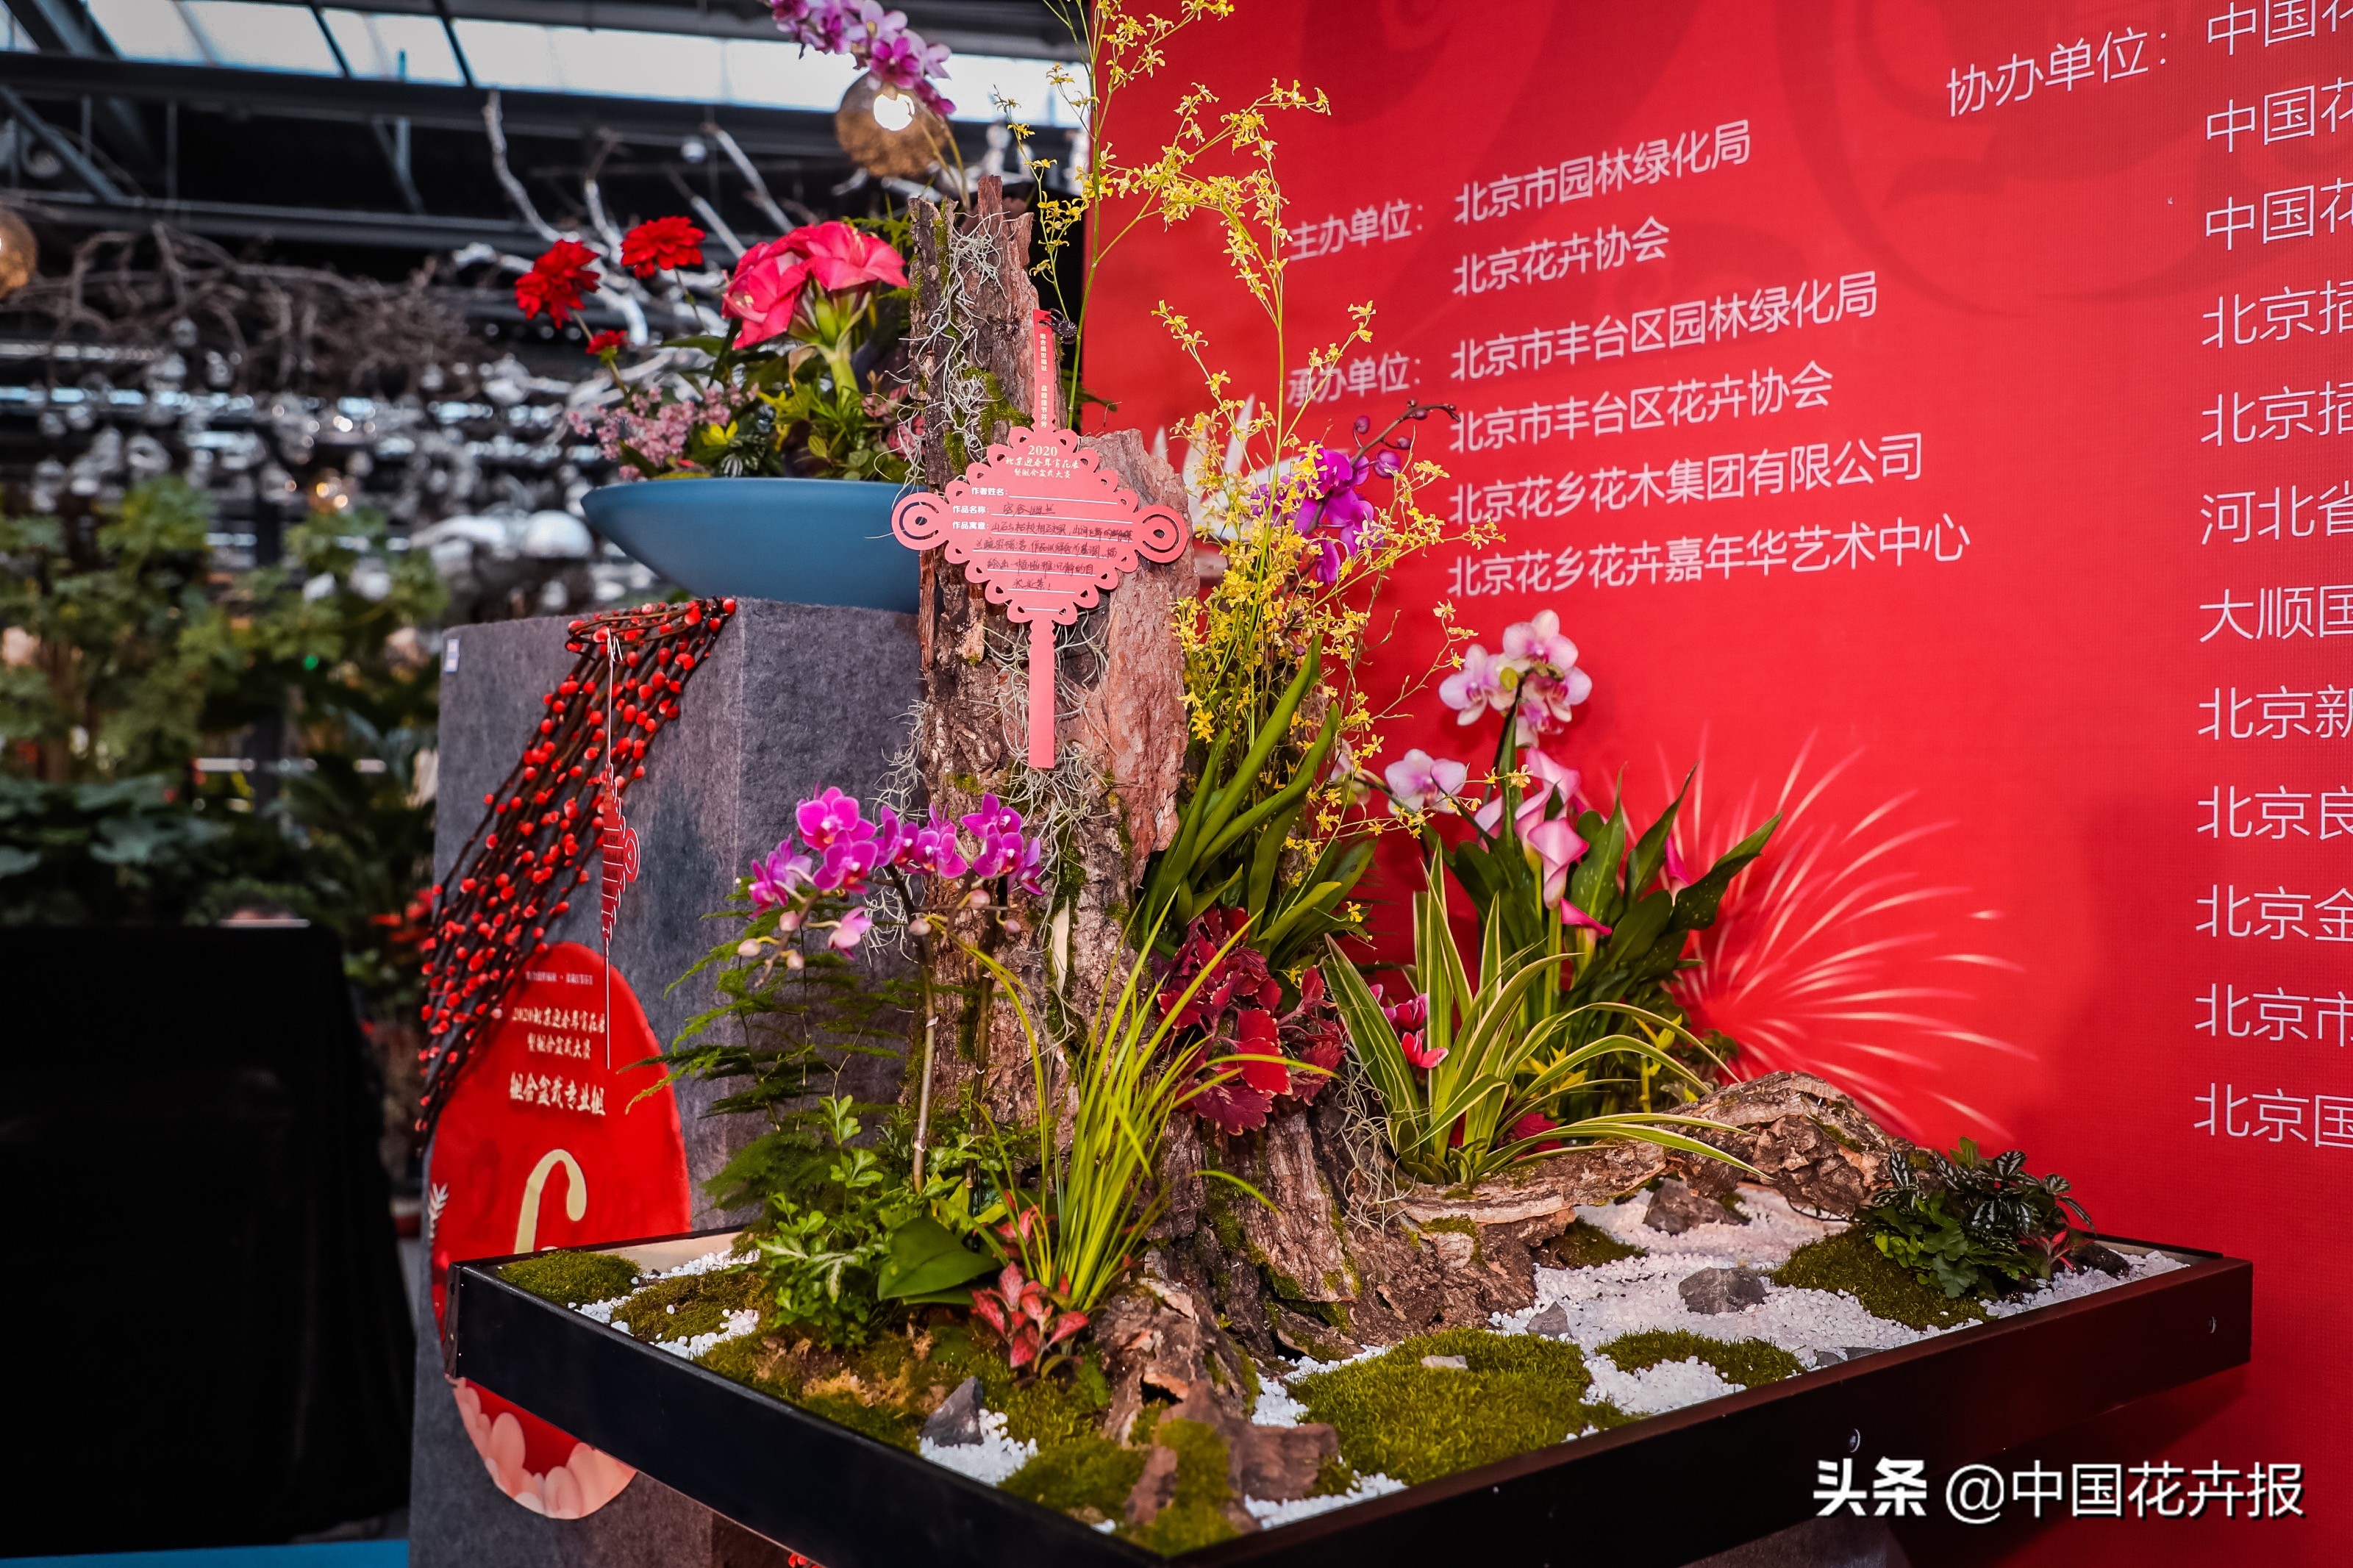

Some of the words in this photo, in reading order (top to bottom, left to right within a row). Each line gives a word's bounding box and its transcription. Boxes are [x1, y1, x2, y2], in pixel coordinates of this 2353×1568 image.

[1946, 26, 2166, 117] 协办单位：
[1289, 198, 1423, 261] 主办单位：
[1454, 120, 1750, 226] 北京市园林绿化局
[1453, 216, 1670, 296] 北京花卉协会
[1287, 351, 1421, 407] 承办单位：
[1451, 271, 1877, 382] 北京市丰台区园林绿化局
[1449, 361, 1834, 454] 北京市丰台区花卉协会
[1028, 445, 1058, 457] 2020
[1448, 433, 1923, 526] 北京花乡花木集团有限公司
[952, 505, 990, 514] 作品名称：
[971, 487, 1008, 496] 作者姓名：
[2200, 480, 2353, 545] 河北省
[951, 521, 989, 530] 作品寓意：
[1447, 512, 1971, 598] 北京花乡花卉嘉年华艺术中心
[2198, 684, 2353, 740] 北京新
[2196, 884, 2353, 942] 北京金
[2195, 983, 2353, 1047] 北京市
[2193, 1083, 2353, 1148] 北京国
